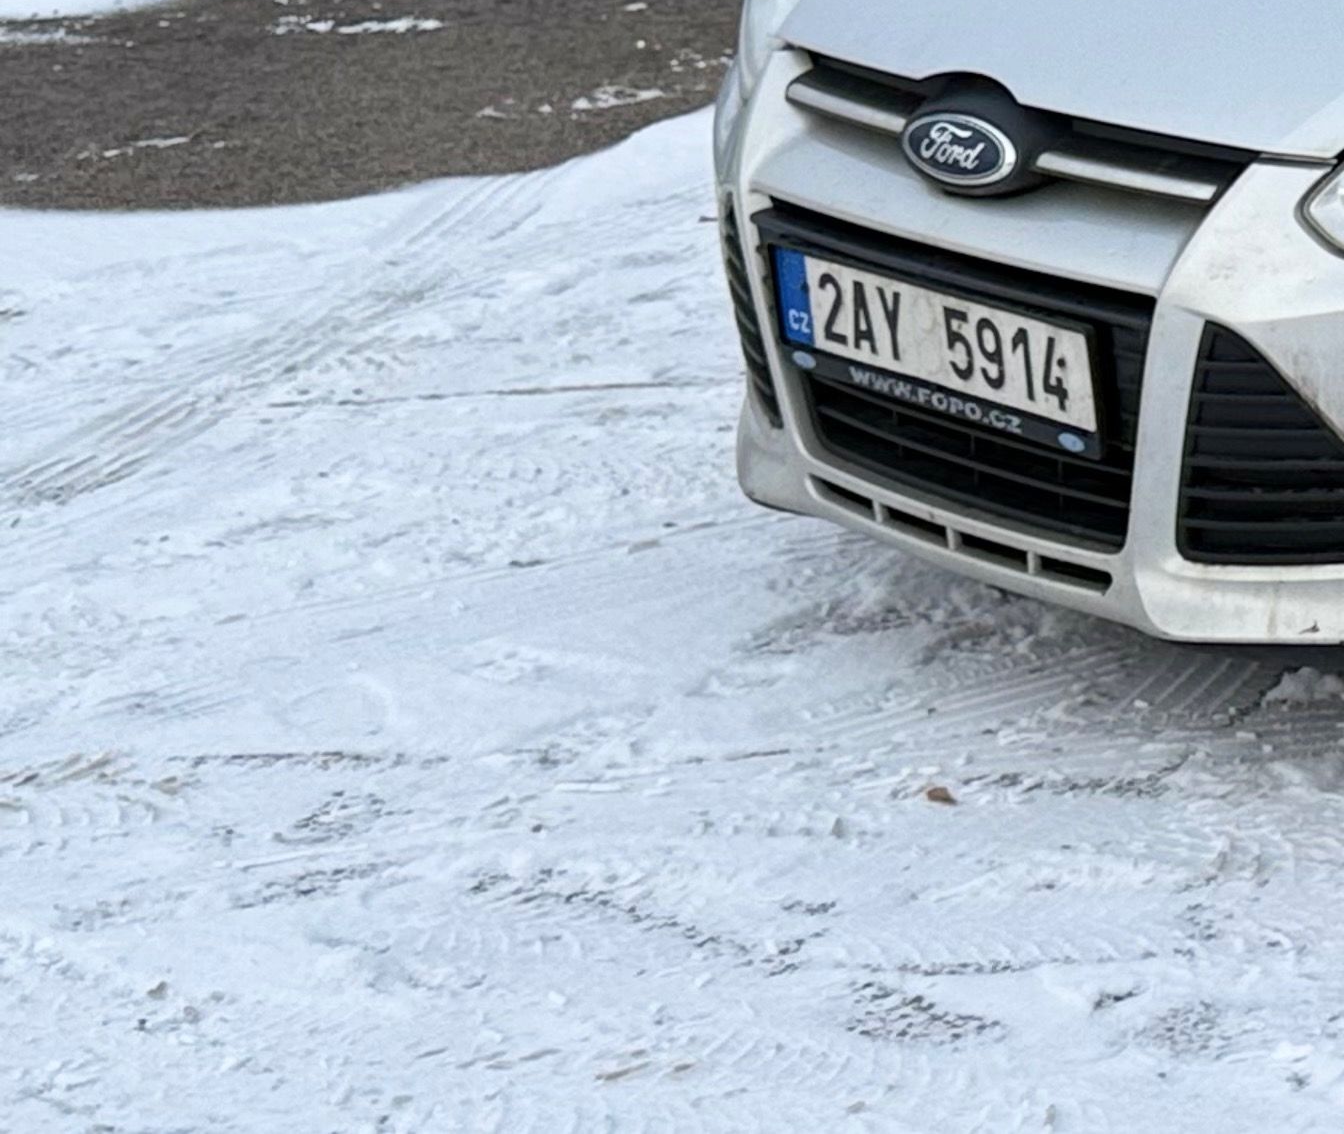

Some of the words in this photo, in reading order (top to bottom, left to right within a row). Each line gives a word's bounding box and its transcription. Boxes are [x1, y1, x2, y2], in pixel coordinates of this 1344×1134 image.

[919, 120, 985, 170] Ford
[787, 308, 811, 335] CZ
[817, 272, 902, 361] 2AY
[942, 304, 1069, 413] 5914
